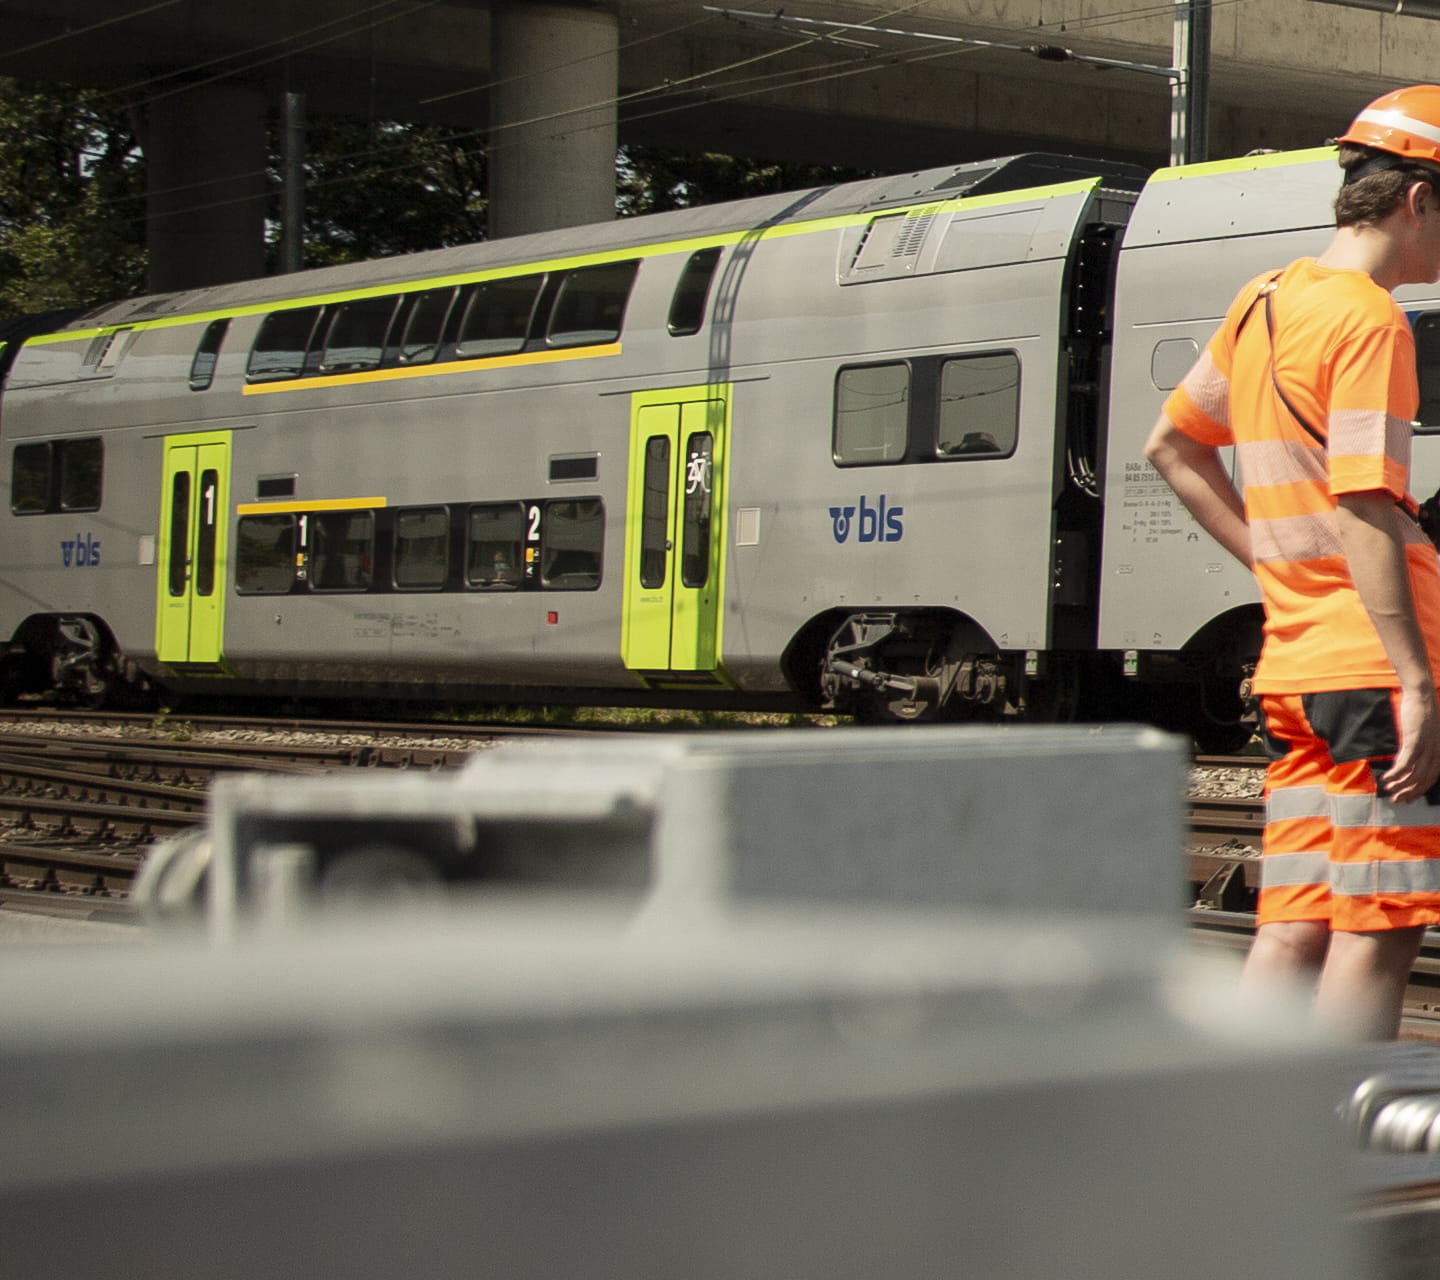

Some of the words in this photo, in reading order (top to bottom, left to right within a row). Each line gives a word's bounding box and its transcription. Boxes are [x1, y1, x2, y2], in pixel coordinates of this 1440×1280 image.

[204, 485, 215, 525] 1
[527, 505, 541, 541] 2
[859, 494, 904, 542] bls
[298, 514, 308, 547] 1
[76, 533, 101, 567] bls
